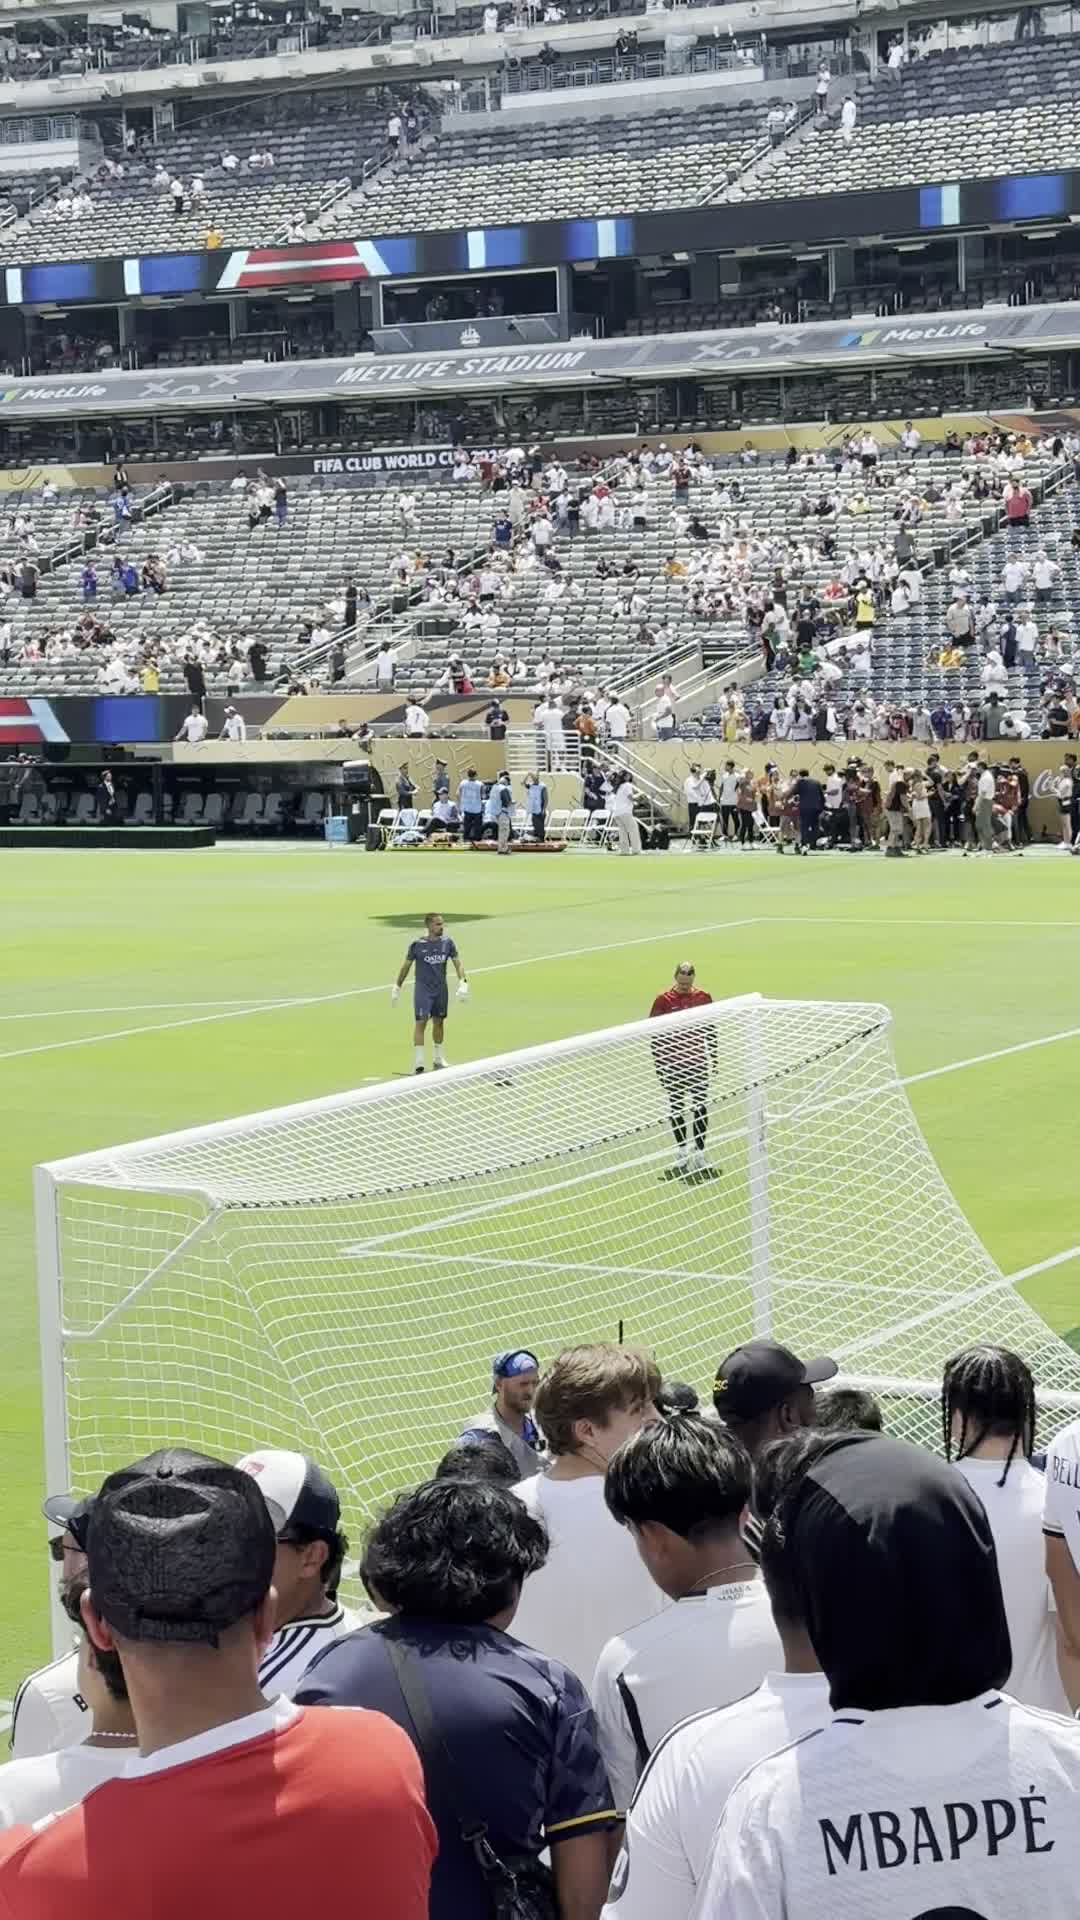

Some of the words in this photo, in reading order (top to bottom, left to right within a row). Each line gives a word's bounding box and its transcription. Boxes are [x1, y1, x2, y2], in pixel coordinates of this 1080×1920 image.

[881, 323, 987, 342] MetLife
[336, 360, 456, 384] METLIFE
[457, 351, 586, 375] STADIUM
[20, 385, 107, 400] MetLife
[313, 459, 344, 473] FIFA
[345, 456, 382, 471] CLUB
[383, 453, 436, 470] WORLD
[818, 1785, 1055, 1875] MBAPPÉ
